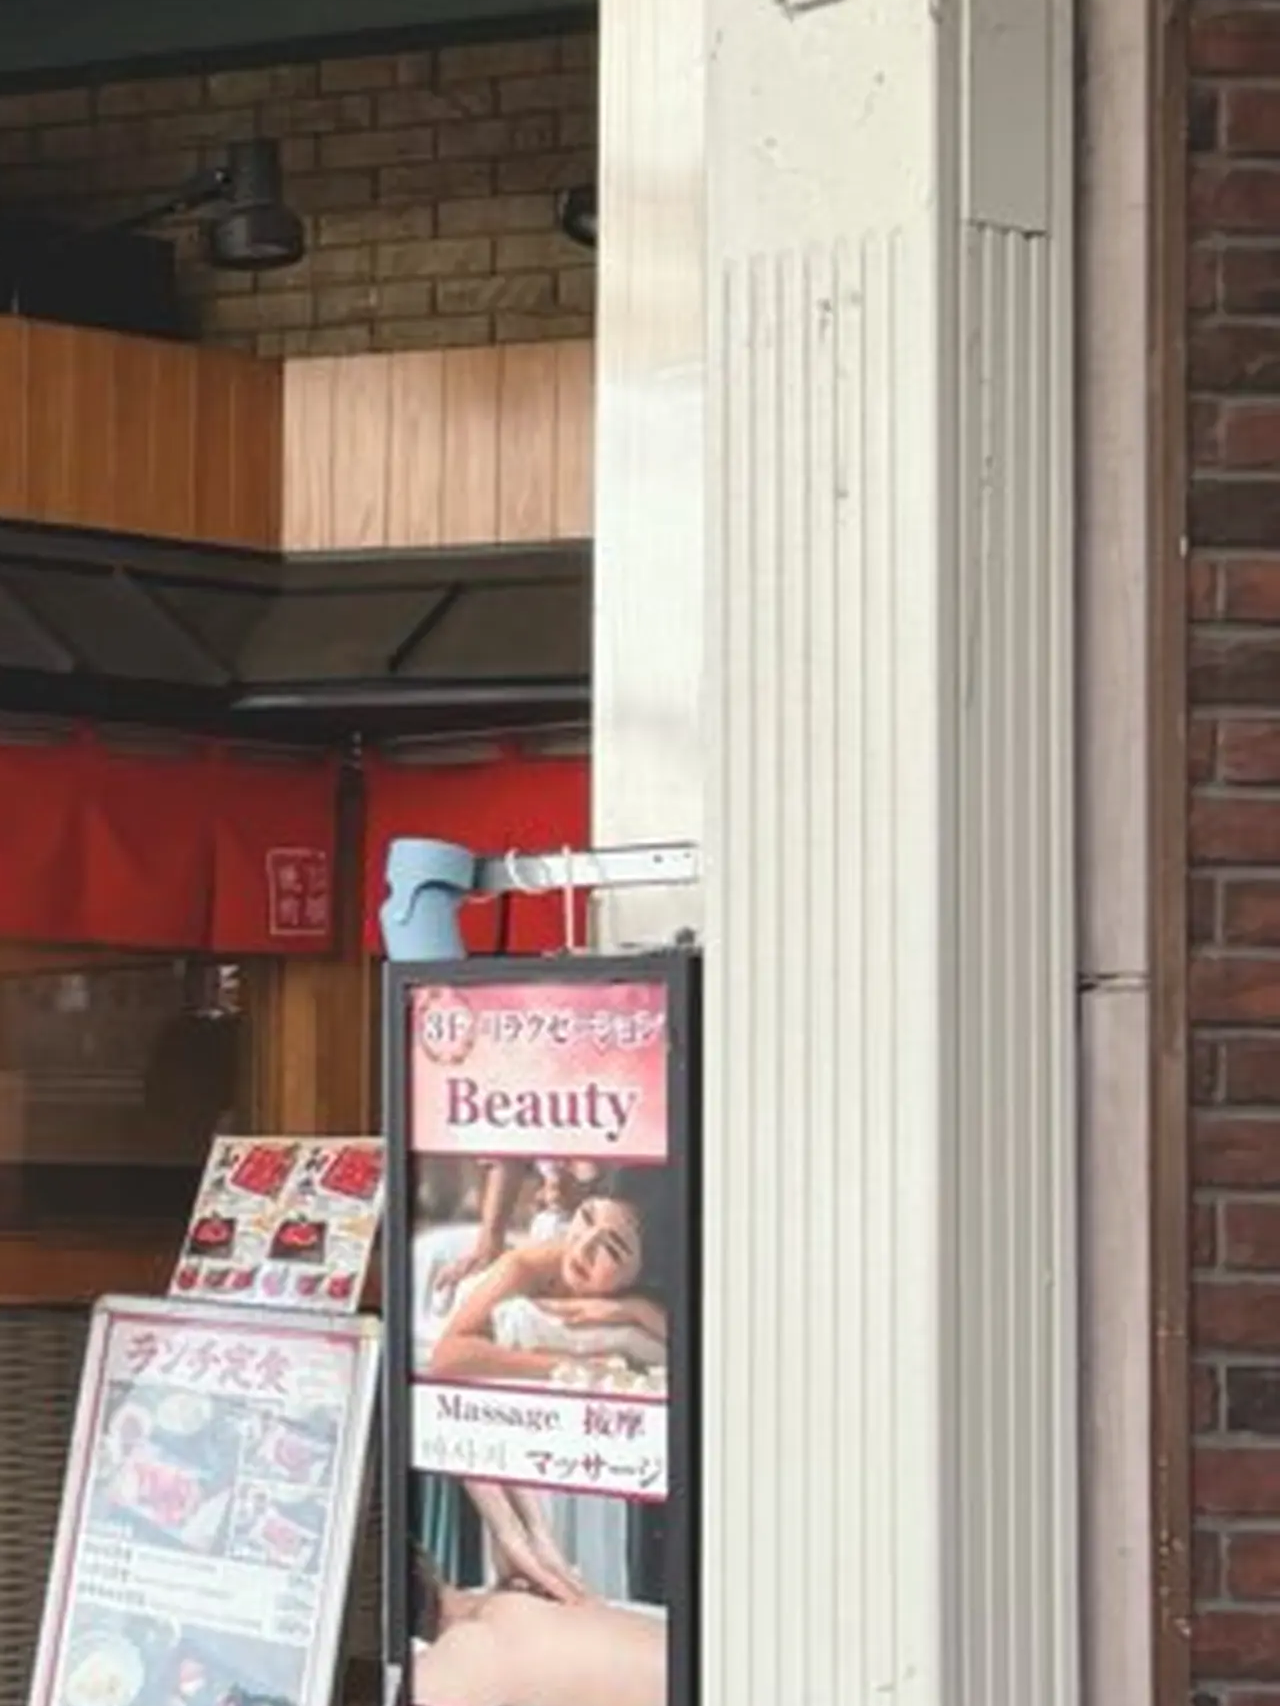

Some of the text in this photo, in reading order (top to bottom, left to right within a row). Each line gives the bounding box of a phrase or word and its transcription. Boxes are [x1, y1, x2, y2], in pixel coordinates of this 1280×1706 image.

[447, 1078, 638, 1143] Beauty
[437, 1394, 560, 1431] Massage
[525, 1449, 662, 1489] マッサージ
